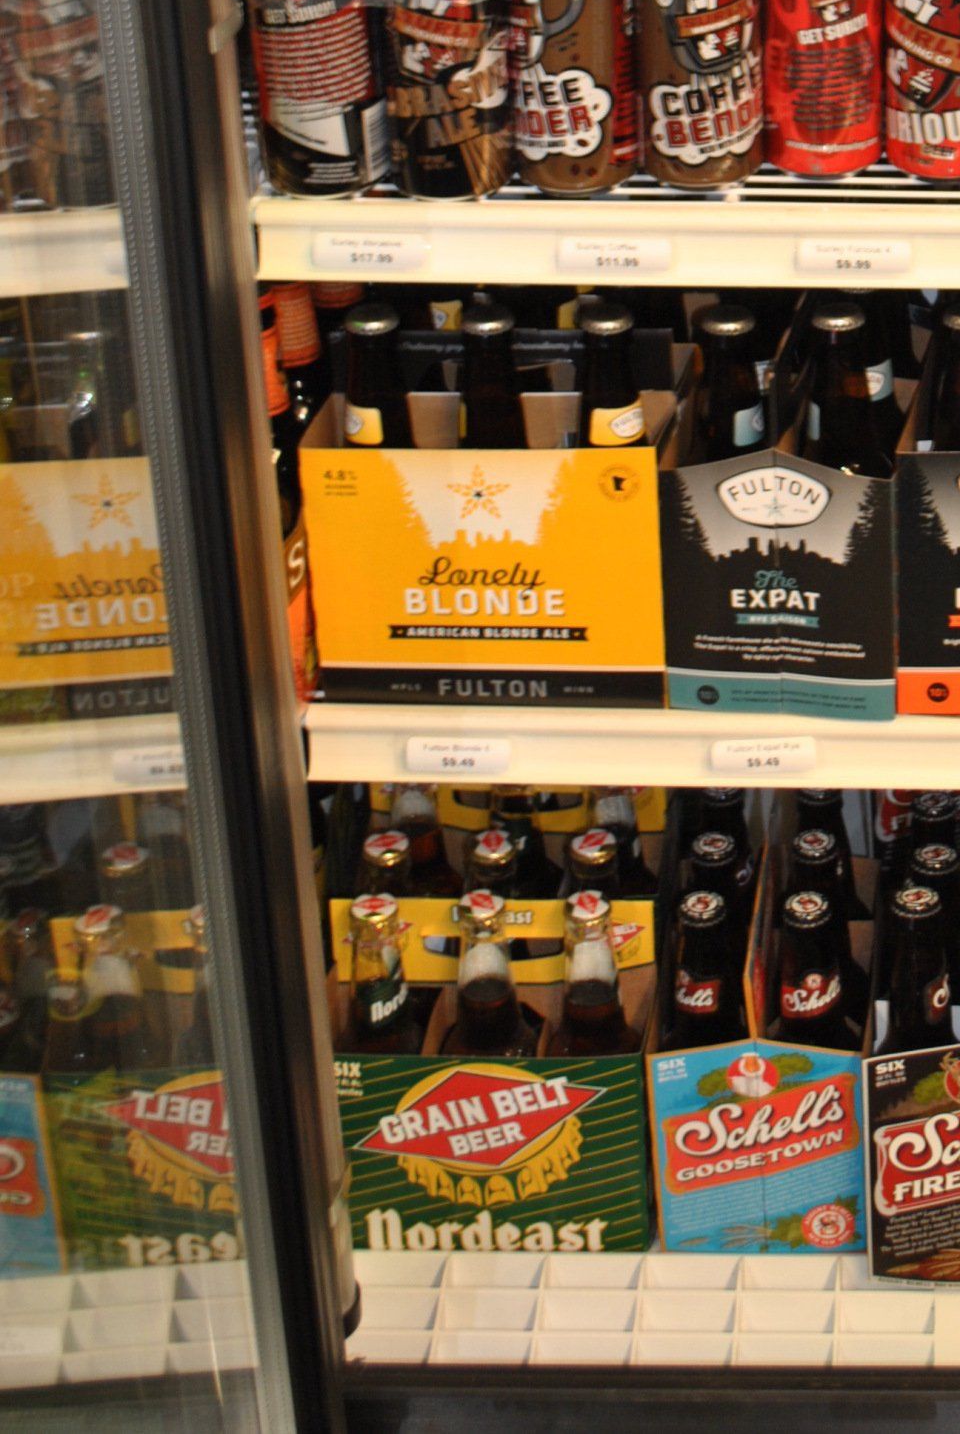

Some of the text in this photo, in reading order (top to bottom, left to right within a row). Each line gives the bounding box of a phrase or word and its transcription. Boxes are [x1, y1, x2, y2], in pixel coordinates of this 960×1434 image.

[427, 108, 481, 148] ALE
[350, 252, 394, 264] $17.99
[836, 259, 872, 270] $9.99
[727, 474, 822, 507] FULTON
[418, 556, 546, 601] Lonely
[754, 569, 799, 589] The
[404, 588, 567, 617] BLONDE
[729, 589, 821, 613] EXPAT
[768, 613, 807, 625] SAISON
[406, 627, 571, 640] AMERICAN BLONDE ALE
[437, 678, 550, 698] FULTON
[441, 757, 476, 768] $9.49
[746, 757, 780, 768] $9.49
[333, 1061, 361, 1078] SIX
[656, 1056, 687, 1069] SIX
[874, 1058, 905, 1074] SIX
[378, 1076, 571, 1146] GRAIN BELT
[673, 1082, 845, 1158] Schell's
[447, 1120, 527, 1158] BEER
[675, 1127, 845, 1183] GOOSETOWN
[364, 1207, 610, 1252] Nordeast
